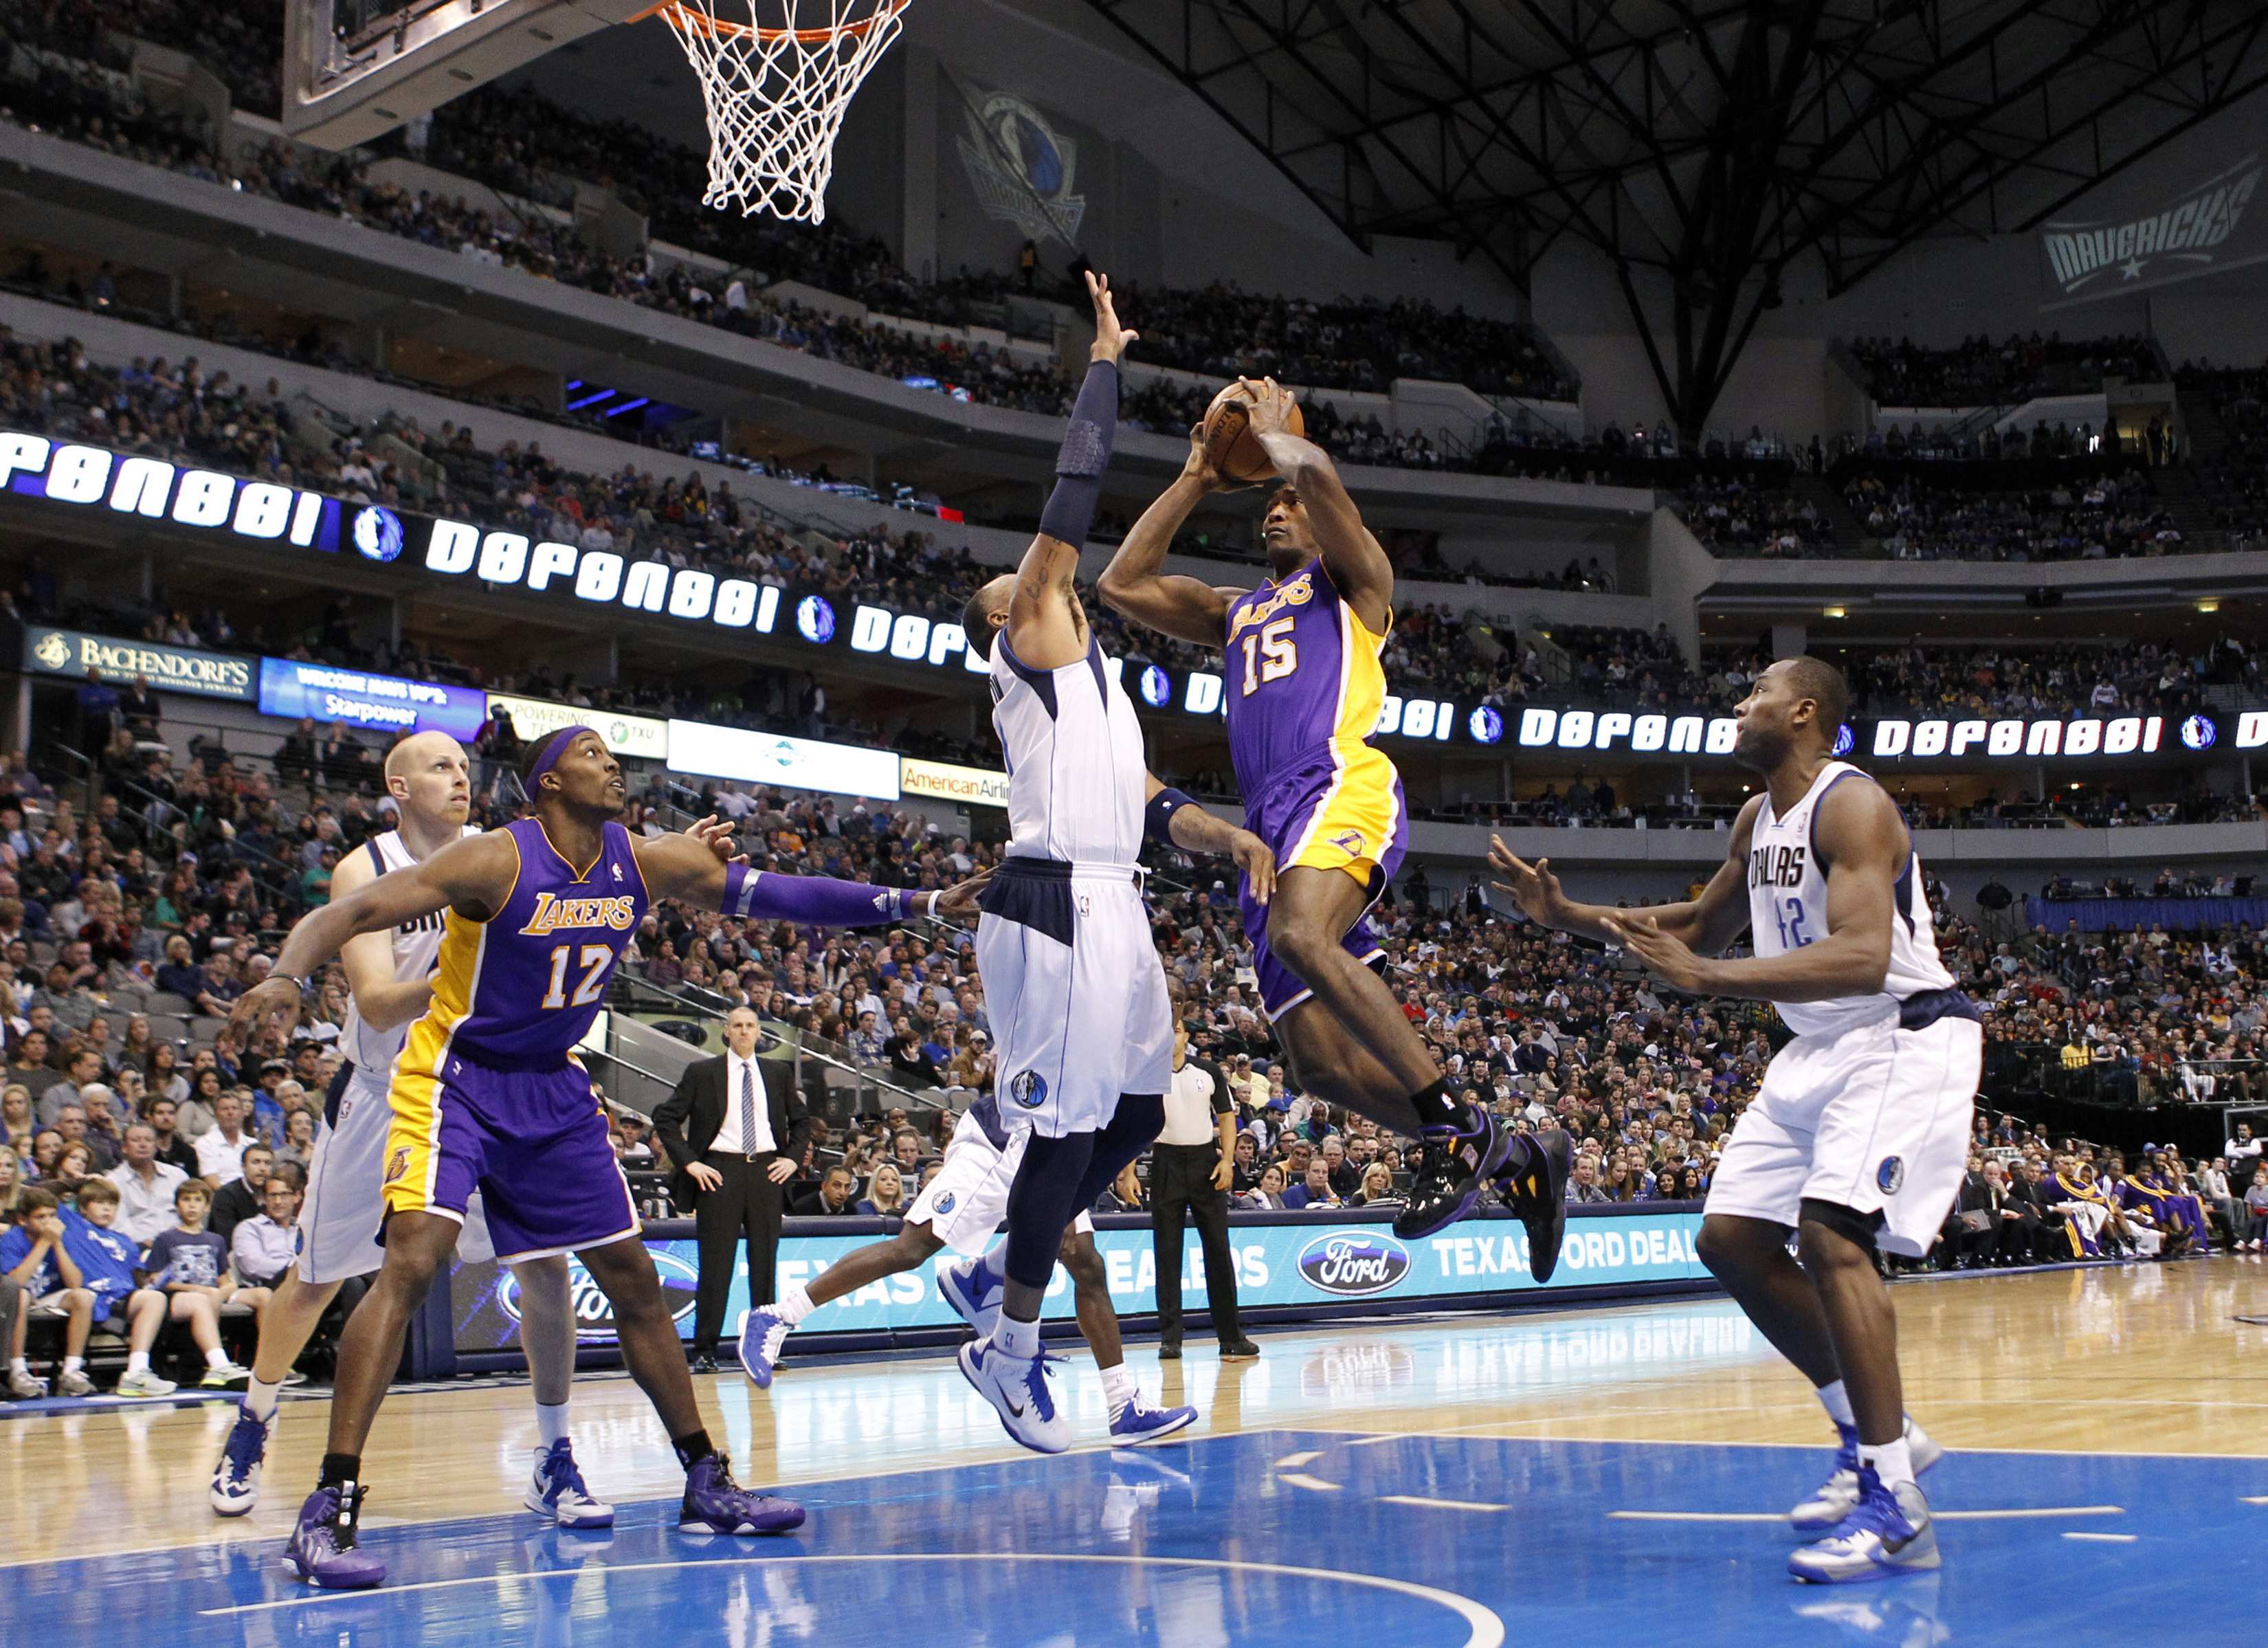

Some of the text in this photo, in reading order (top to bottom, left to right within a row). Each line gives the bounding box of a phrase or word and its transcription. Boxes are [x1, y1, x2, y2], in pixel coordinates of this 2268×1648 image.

[2043, 166, 2263, 283] MAVERICKS
[1242, 616, 1298, 698] 15
[325, 694, 418, 725] Starpower
[514, 703, 590, 727] POWERING
[631, 726, 654, 740] TXU
[518, 892, 635, 936] LAKERS
[542, 944, 614, 1010] 12
[1320, 1238, 1390, 1284] Ford
[1559, 1232, 1626, 1270] ORD
